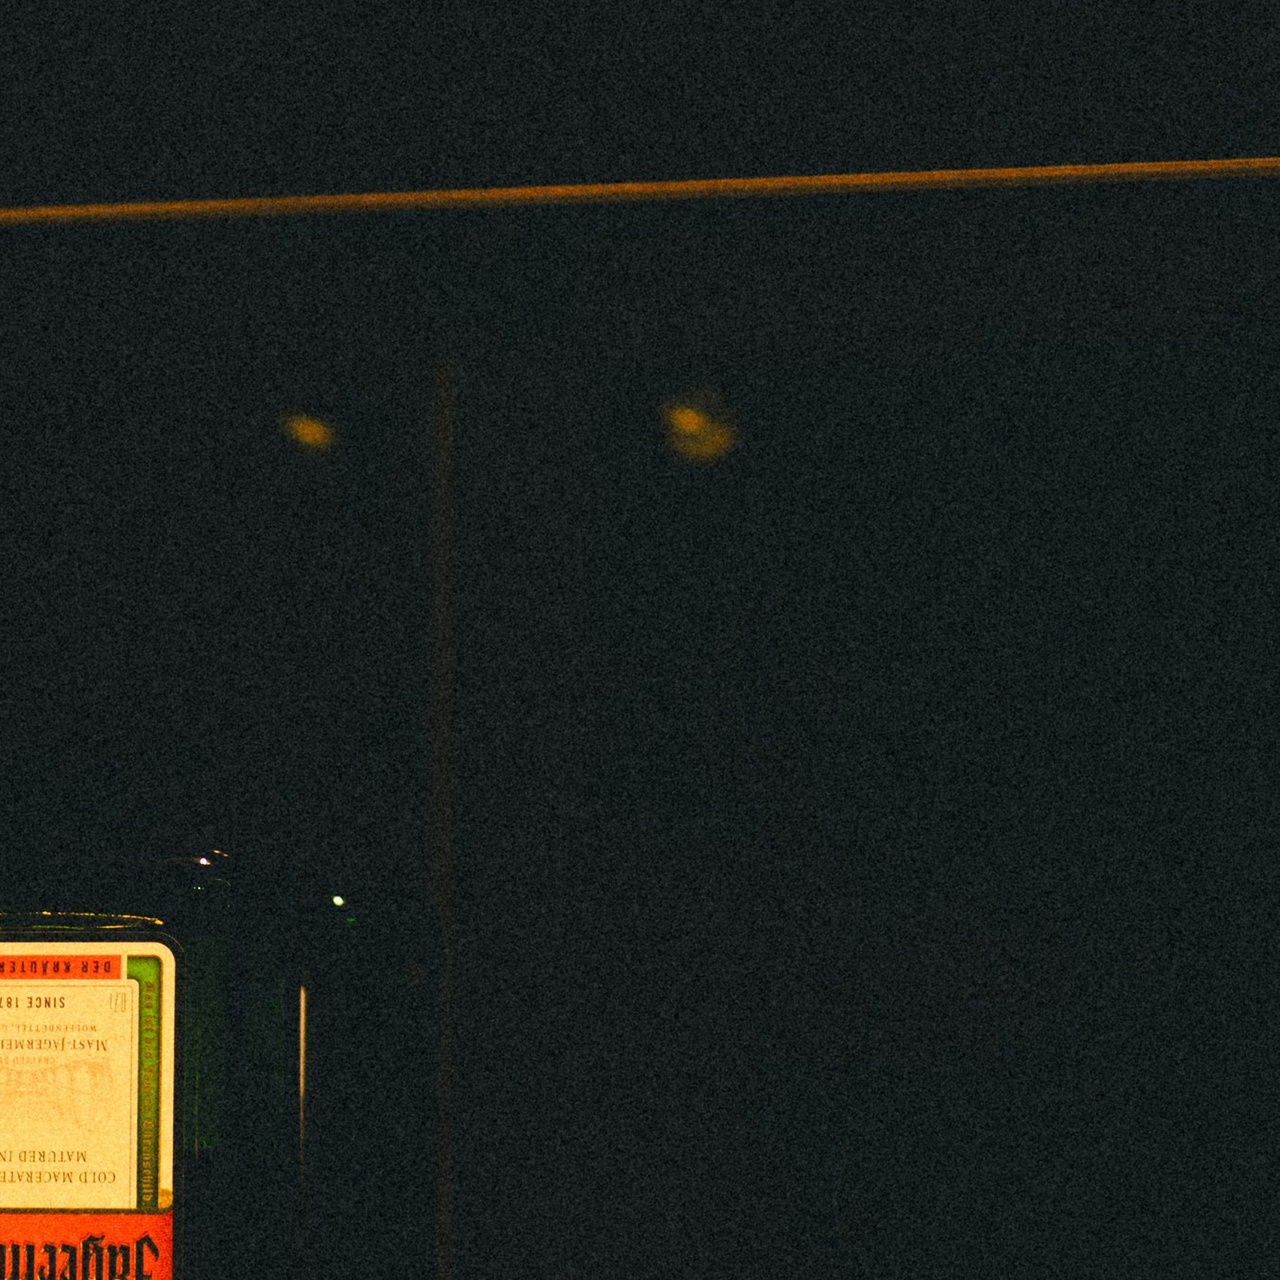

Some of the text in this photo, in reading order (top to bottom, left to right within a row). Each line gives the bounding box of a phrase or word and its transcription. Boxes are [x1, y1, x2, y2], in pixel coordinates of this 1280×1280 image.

[81, 960, 111, 973] DER
[27, 996, 66, 1009] SINCE
[19, 1150, 87, 1163] MATURED
[78, 1170, 116, 1184] COLD
